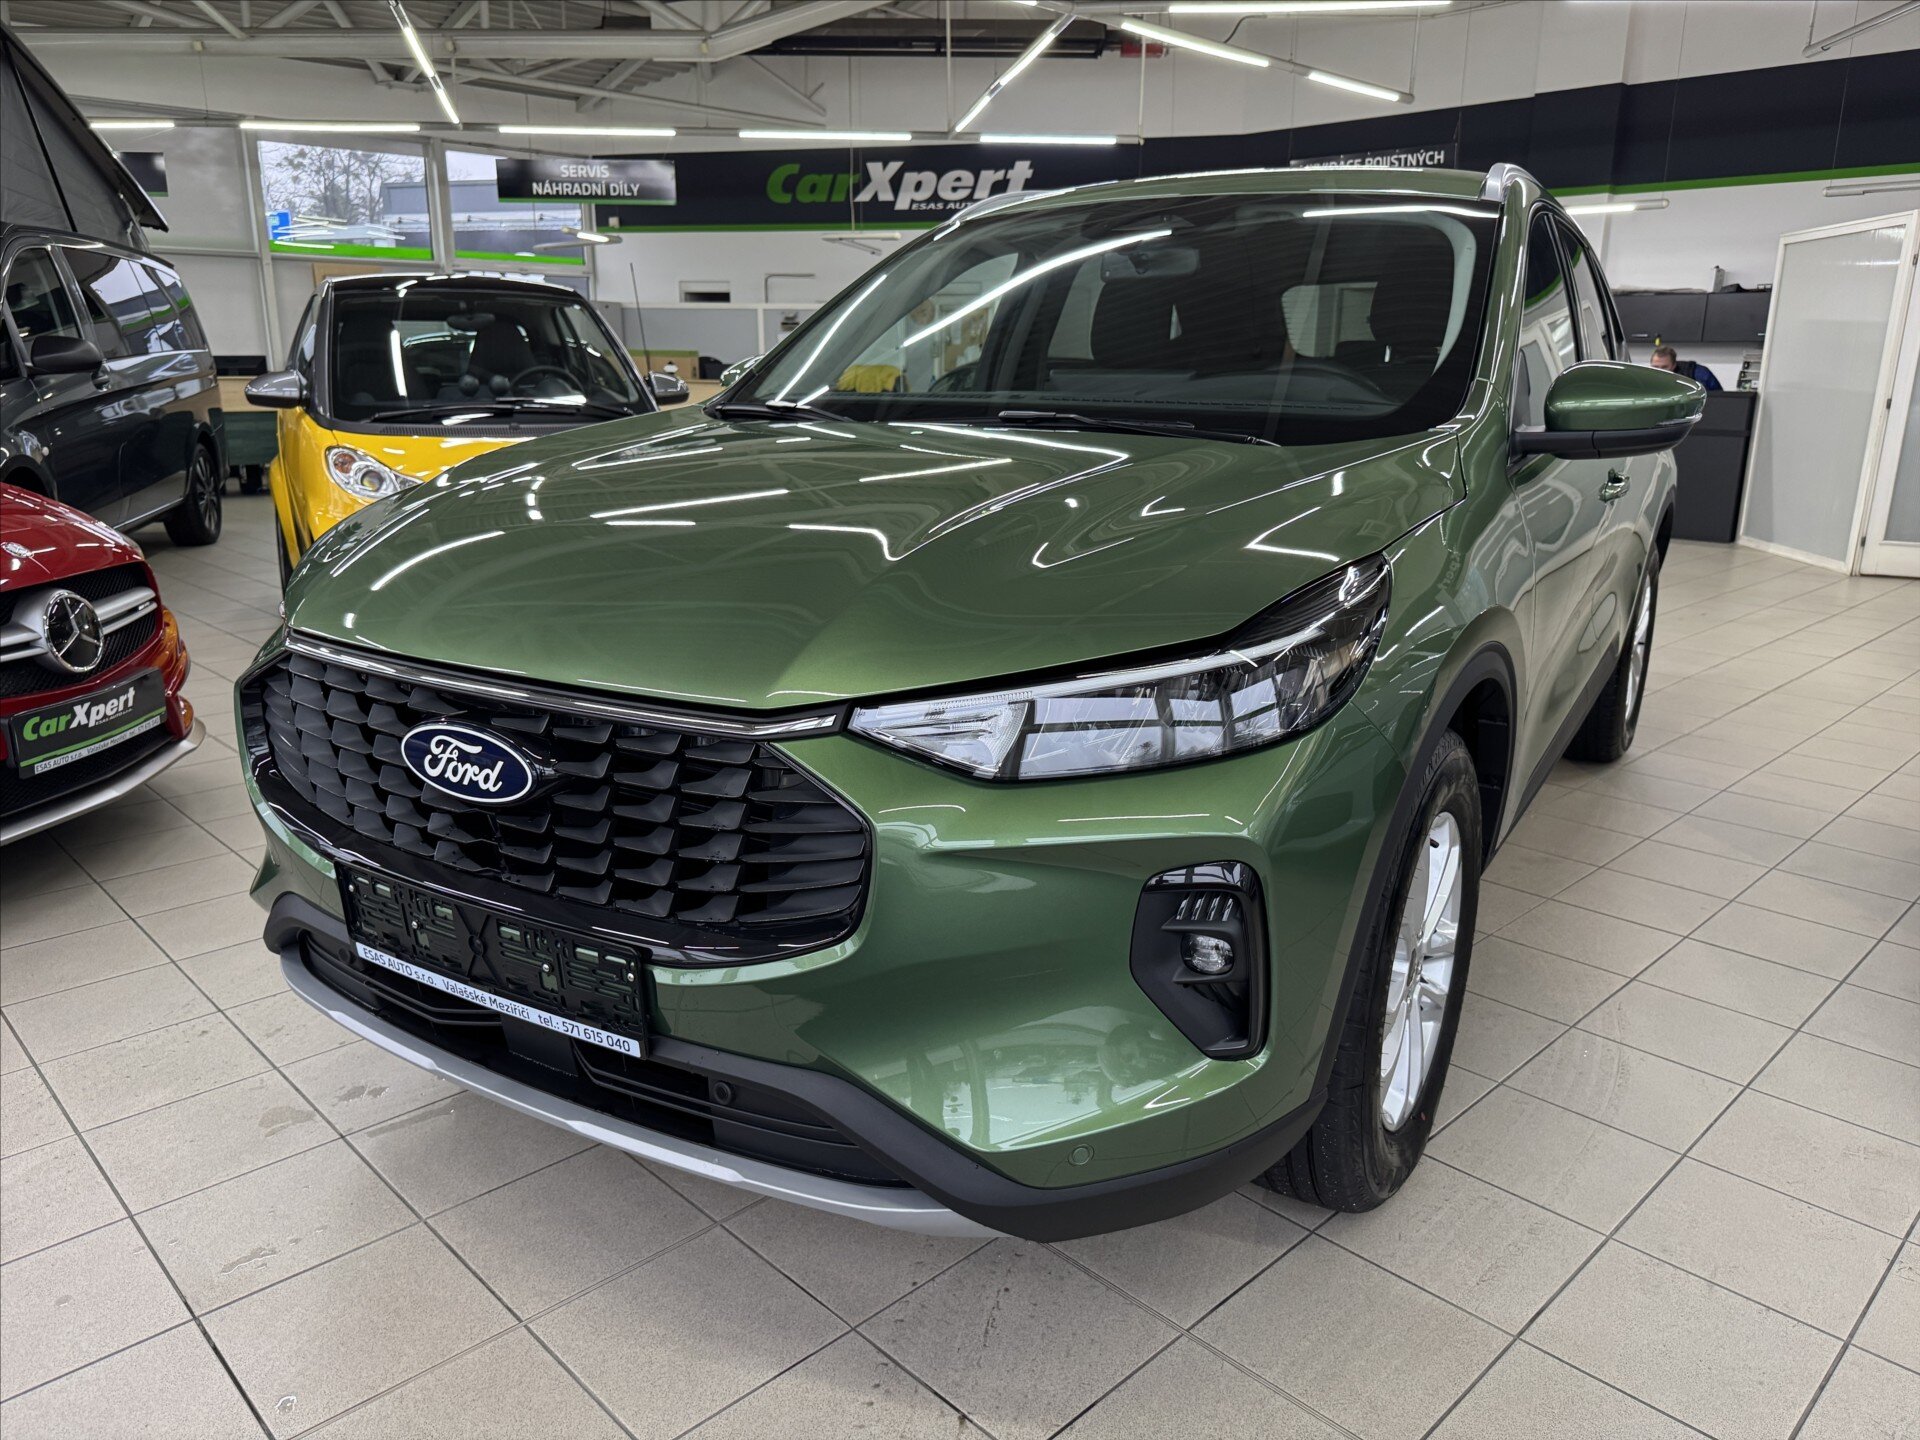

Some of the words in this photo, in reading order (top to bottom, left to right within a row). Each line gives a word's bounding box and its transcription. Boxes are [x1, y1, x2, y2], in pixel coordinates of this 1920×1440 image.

[532, 180, 607, 196] NÁHRADNÍ
[609, 180, 640, 196] DÍLY
[560, 164, 610, 178] SERVIS
[766, 160, 1033, 211] CarXpert
[911, 202, 945, 211] ESAS
[946, 202, 976, 210] AUT
[23, 686, 136, 741] CarXpert
[36, 762, 52, 773] ESAS
[53, 755, 70, 766] AUTO
[424, 735, 504, 792] Ford
[363, 947, 386, 966] ESAS
[388, 958, 413, 976] AUTO
[415, 970, 437, 986] s.r.o.
[442, 978, 487, 1005] Valašské
[488, 996, 531, 1020] Meziříčí
[538, 1013, 560, 1030] tel.:
[562, 1020, 581, 1037] 571
[584, 1028, 603, 1044] 615
[607, 1035, 631, 1052] 040
